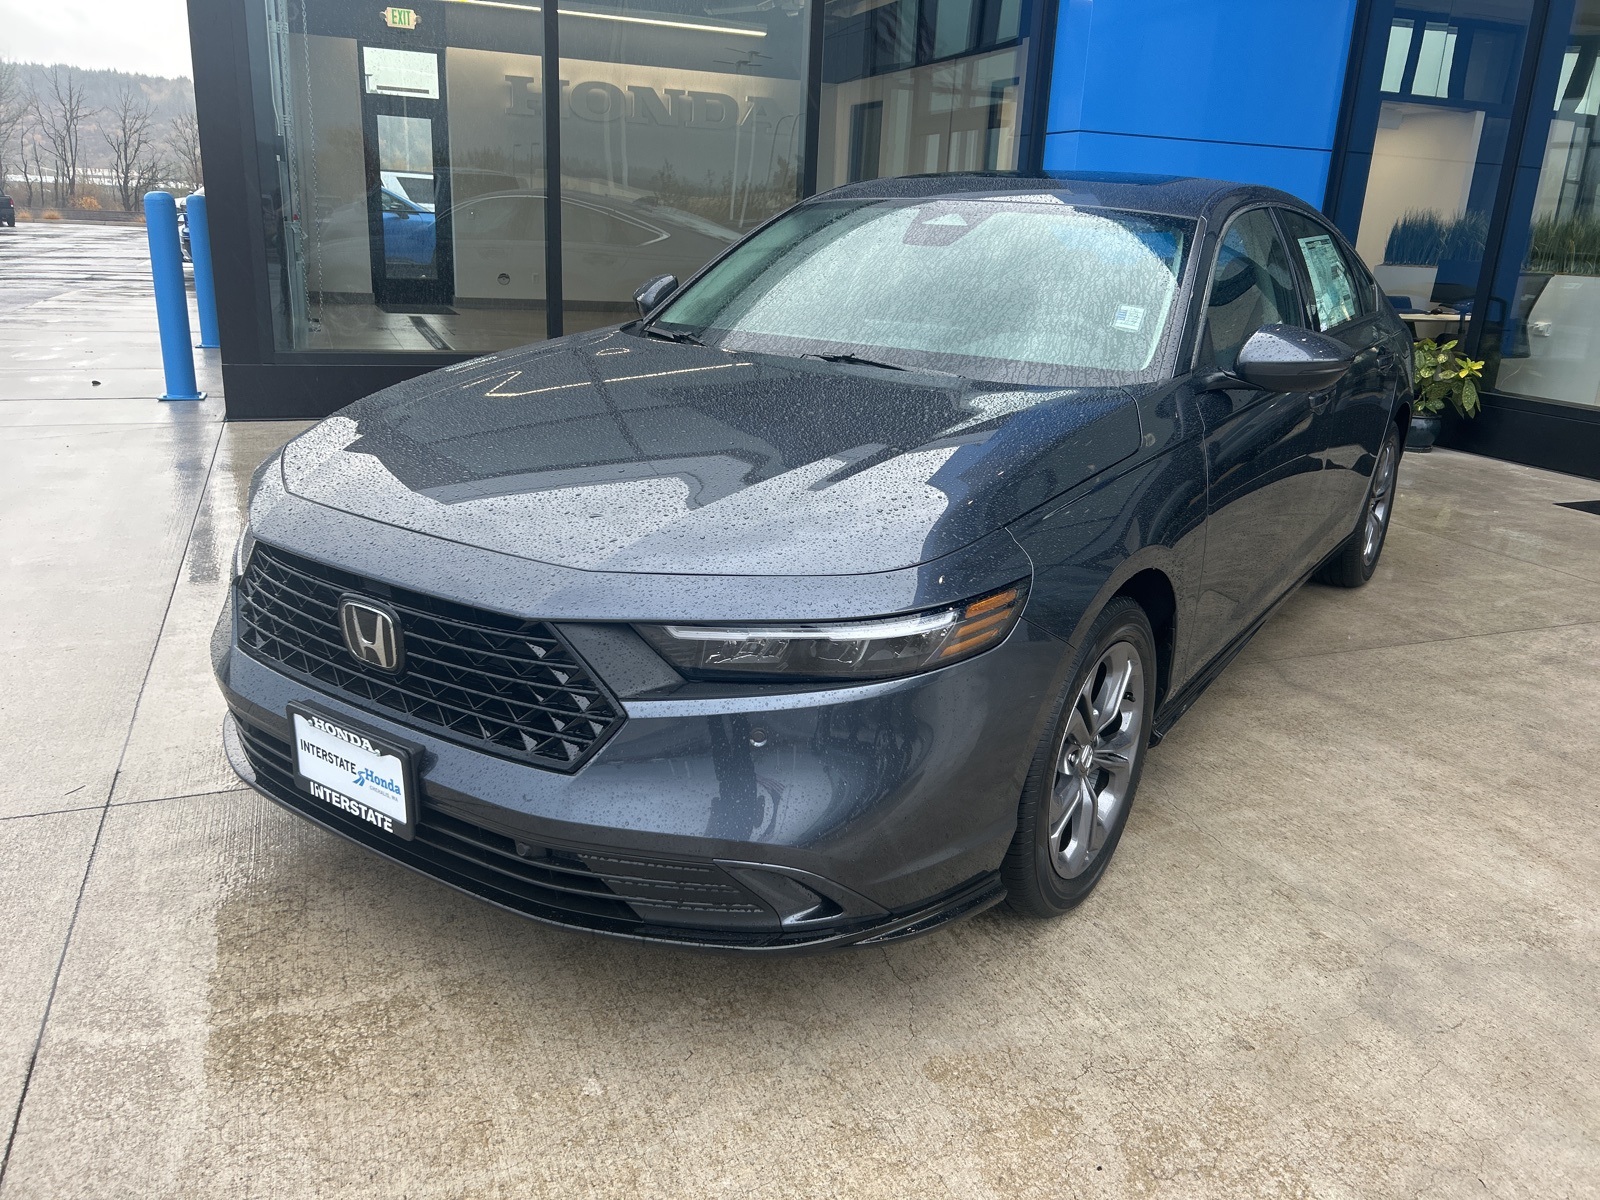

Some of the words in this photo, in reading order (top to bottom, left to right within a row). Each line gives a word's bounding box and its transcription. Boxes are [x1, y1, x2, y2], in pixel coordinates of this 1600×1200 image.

[391, 9, 411, 26] EXIT
[505, 75, 791, 136] HONDA
[311, 716, 377, 754] HONDA
[300, 738, 357, 775] INTERSTATE
[364, 767, 402, 796] Honda
[310, 781, 394, 834] INTERSTATE
